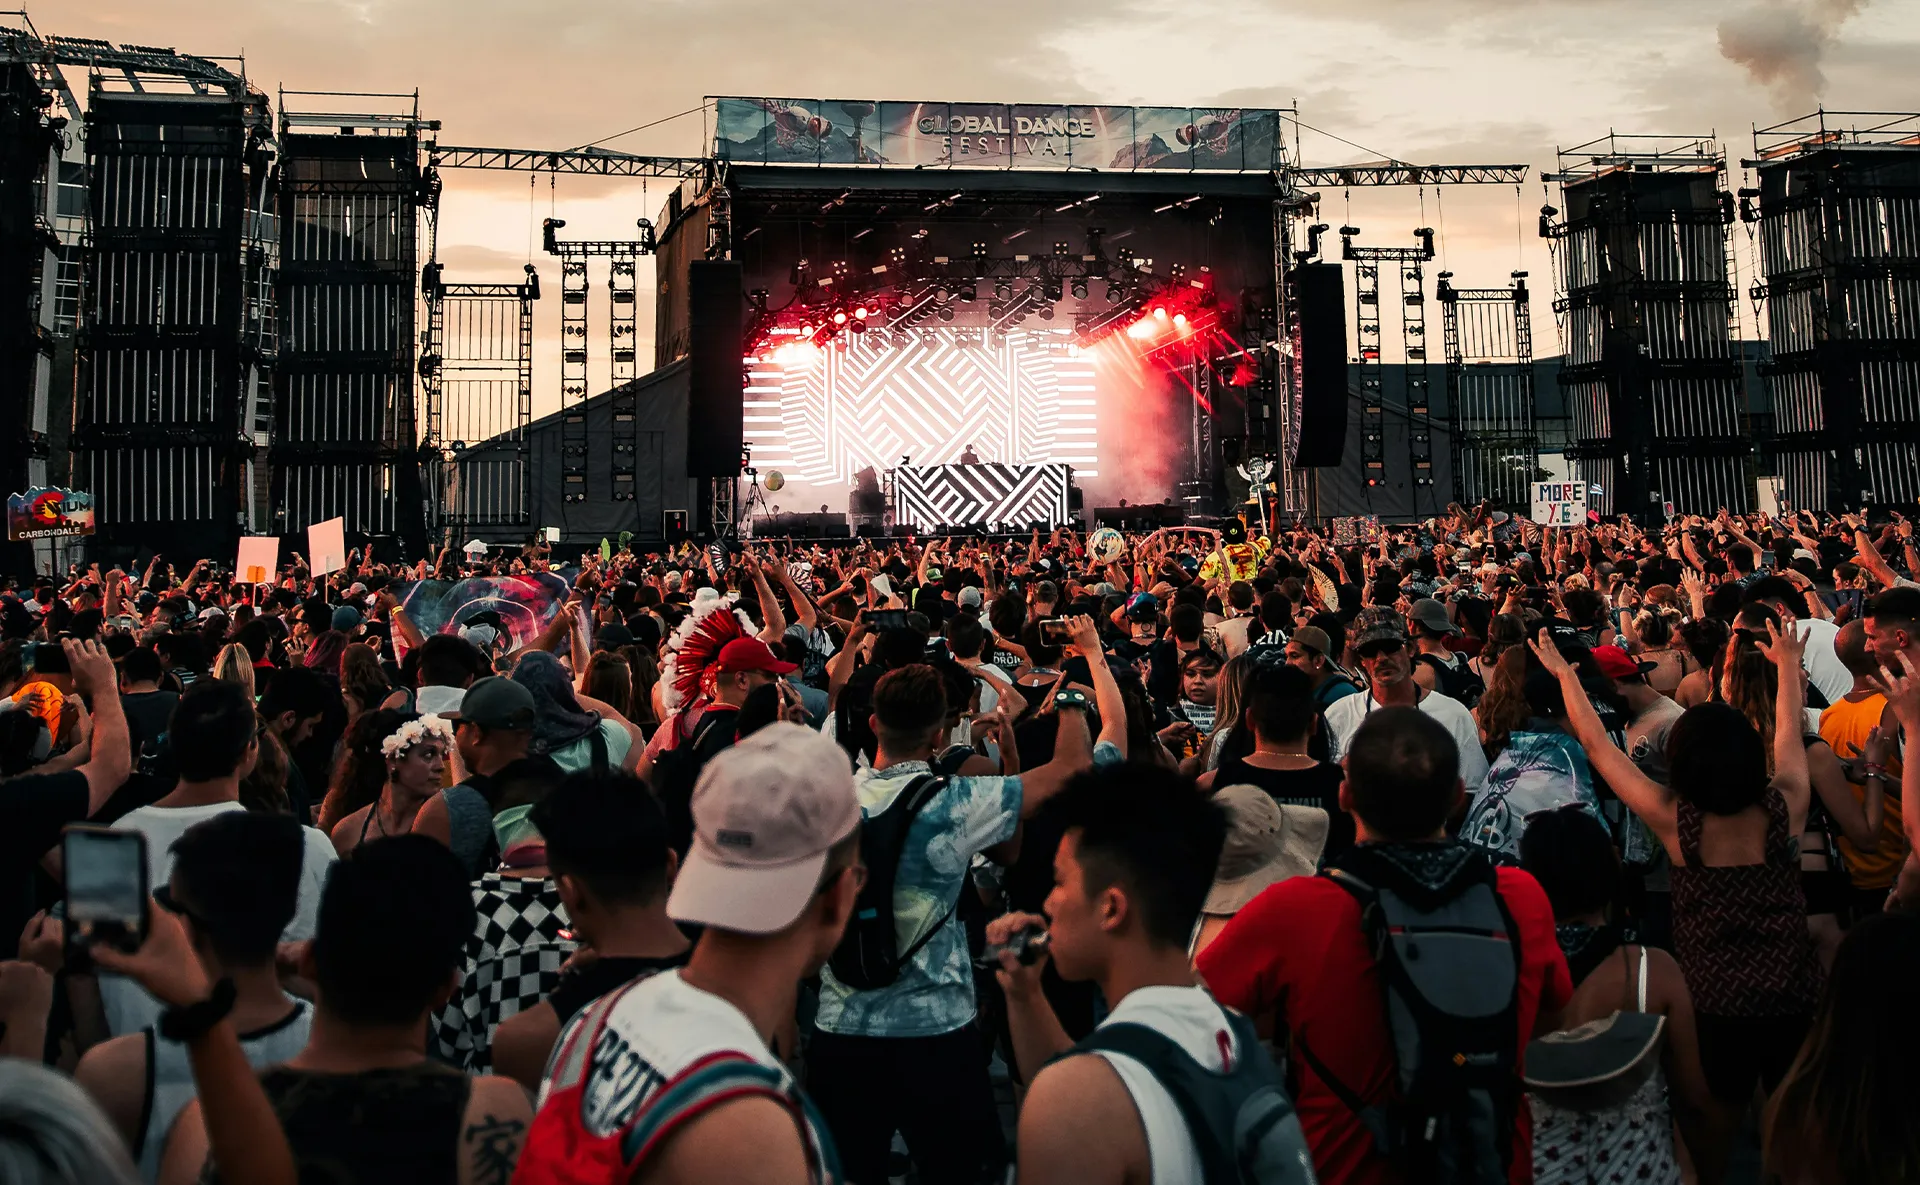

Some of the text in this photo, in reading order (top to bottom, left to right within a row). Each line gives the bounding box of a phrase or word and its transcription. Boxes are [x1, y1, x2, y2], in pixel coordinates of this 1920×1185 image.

[918, 115, 1095, 138] GLOBAL DANCE
[941, 136, 1073, 156] FESTIVAL
[1540, 483, 1582, 502] MORE
[1548, 503, 1570, 524] YE
[19, 527, 81, 539] CARBONDALE
